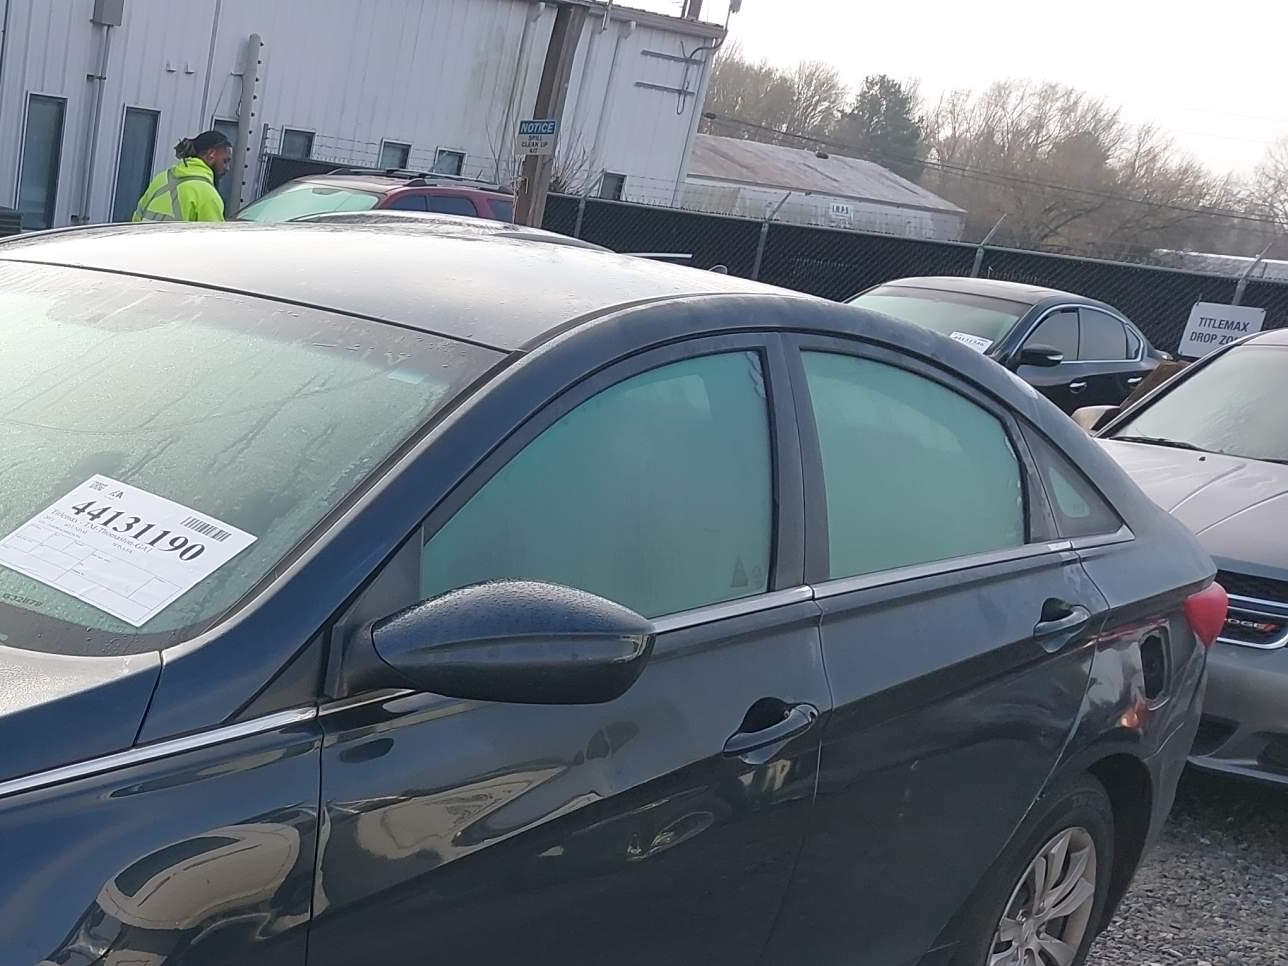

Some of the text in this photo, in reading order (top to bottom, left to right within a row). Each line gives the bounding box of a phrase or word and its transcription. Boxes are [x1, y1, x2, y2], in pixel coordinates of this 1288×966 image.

[521, 122, 555, 133] NOTICE
[1198, 317, 1250, 332] TITLEMAX
[1190, 331, 1217, 343] DROP
[71, 500, 205, 561] 44131190
